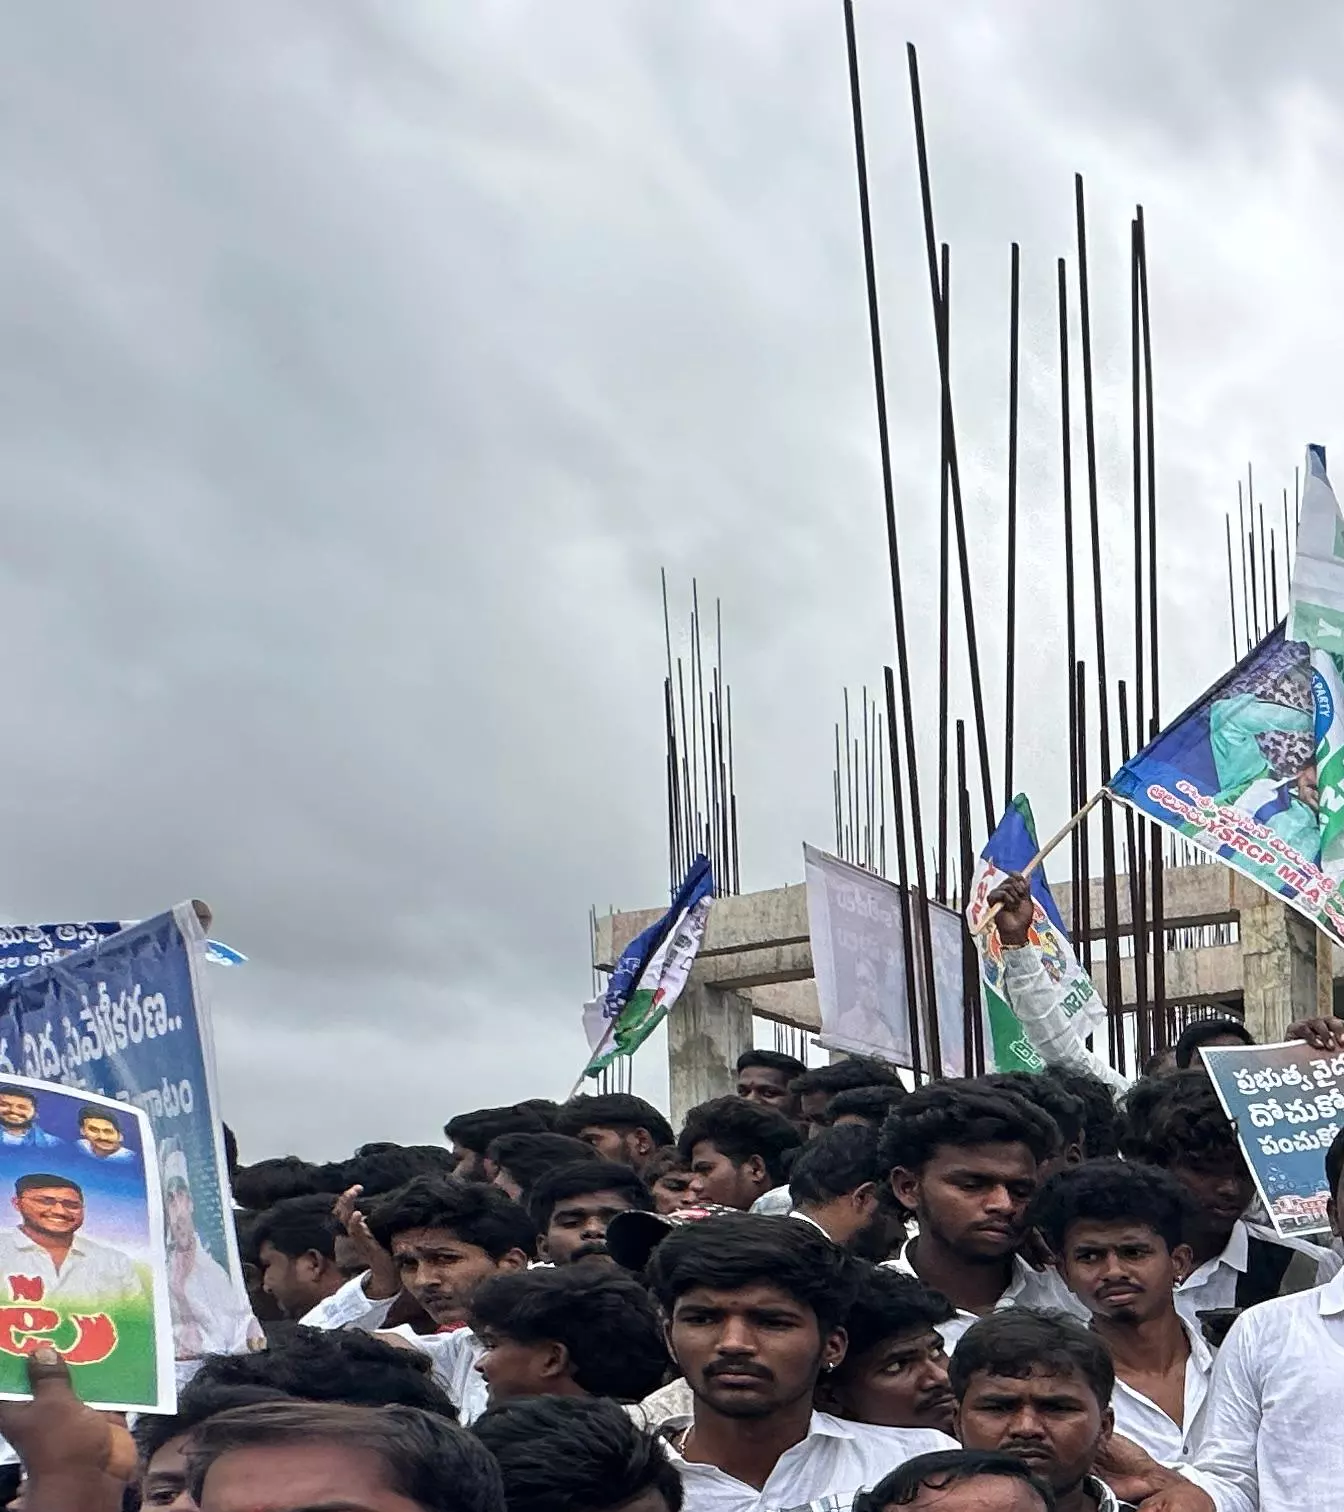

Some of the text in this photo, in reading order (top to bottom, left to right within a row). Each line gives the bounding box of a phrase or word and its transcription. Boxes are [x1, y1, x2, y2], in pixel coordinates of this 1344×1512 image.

[1207, 820, 1276, 867] YSRCP
[1278, 865, 1320, 904] MLA
[1233, 1062, 1311, 1096] ప్రభుత్వ
